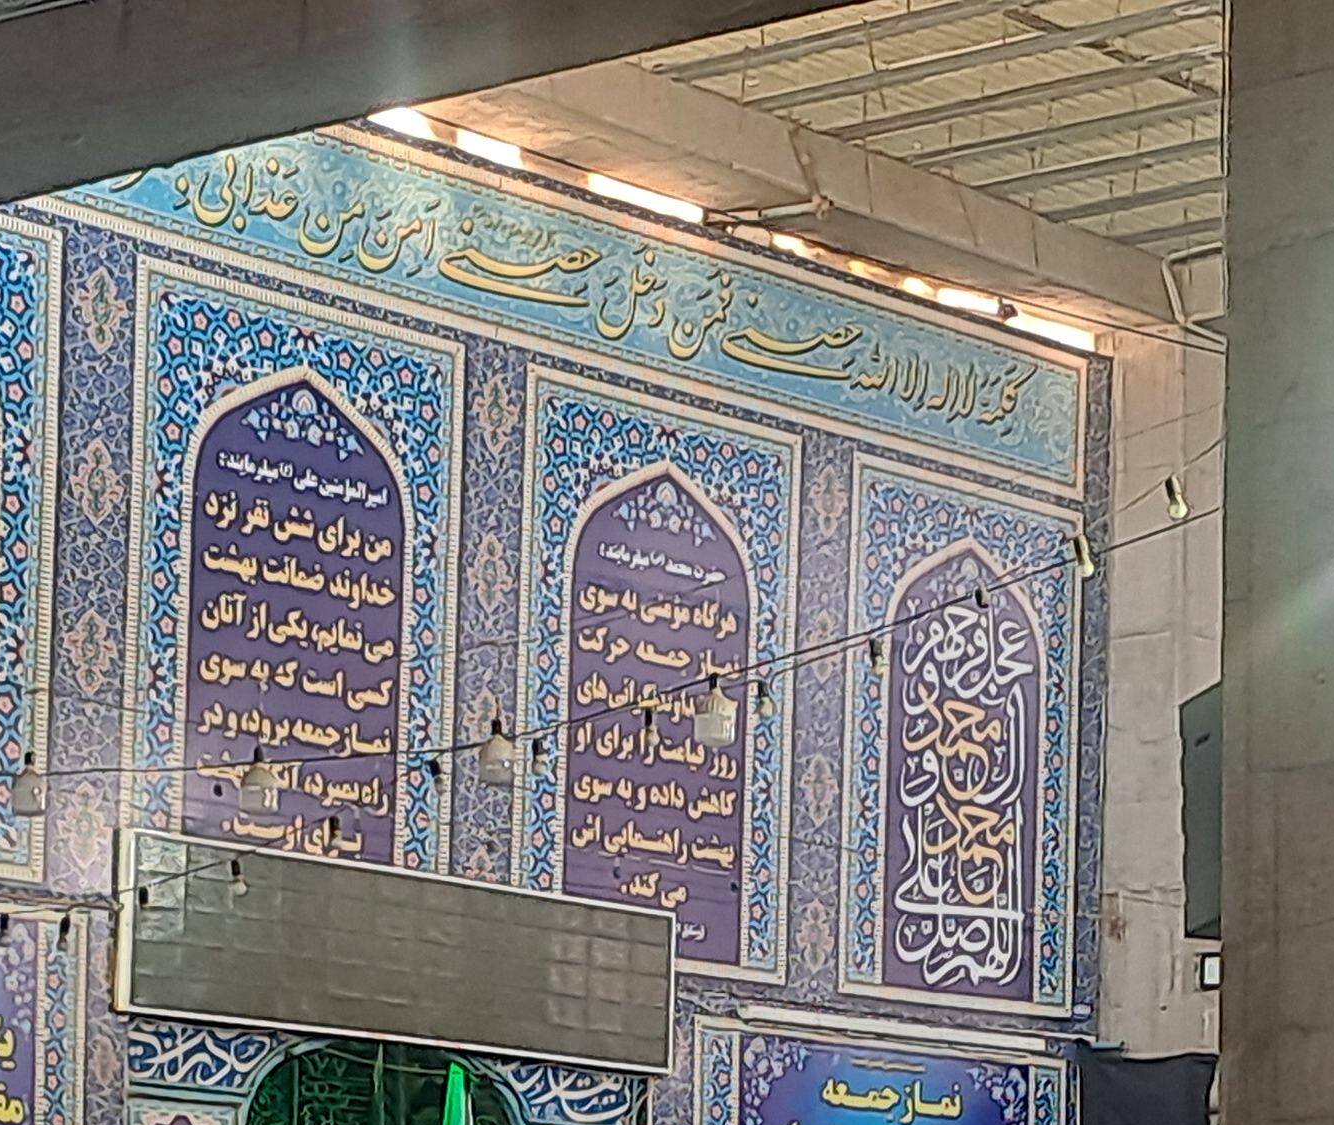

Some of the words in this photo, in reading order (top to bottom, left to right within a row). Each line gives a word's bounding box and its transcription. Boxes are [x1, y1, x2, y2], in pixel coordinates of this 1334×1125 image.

[203, 489, 239, 530] نزد
[239, 497, 272, 536] نفر
[272, 505, 316, 542] شش
[318, 514, 363, 558] برای
[364, 533, 394, 562] من
[200, 542, 259, 586] بهشت
[261, 554, 327, 592] ضمانت
[328, 567, 397, 610] خداوند
[578, 585, 619, 615] سوی
[620, 588, 639, 621] به
[200, 591, 249, 631] آنان
[244, 601, 268, 640] از
[267, 609, 310, 648] یکی
[577, 626, 632, 664] حرکت
[634, 639, 693, 678] جمعه
[198, 652, 249, 687] سوی
[249, 658, 270, 693] به
[273, 659, 300, 689] که
[301, 669, 345, 699] است
[345, 679, 395, 712] کسی
[196, 701, 225, 734] در
[222, 709, 240, 739] و
[289, 716, 343, 752] جمعه
[335, 720, 393, 759] نماز
[574, 721, 593, 753] او
[595, 723, 635, 761] برای
[708, 747, 738, 781] روز
[360, 775, 389, 818] راه
[573, 775, 614, 803] سوی
[616, 777, 634, 808] به
[633, 785, 648, 811] و
[649, 780, 686, 809] داده
[687, 787, 737, 819] کاهش
[820, 1076, 901, 1122] جمعه
[898, 1079, 964, 1125] نماز
